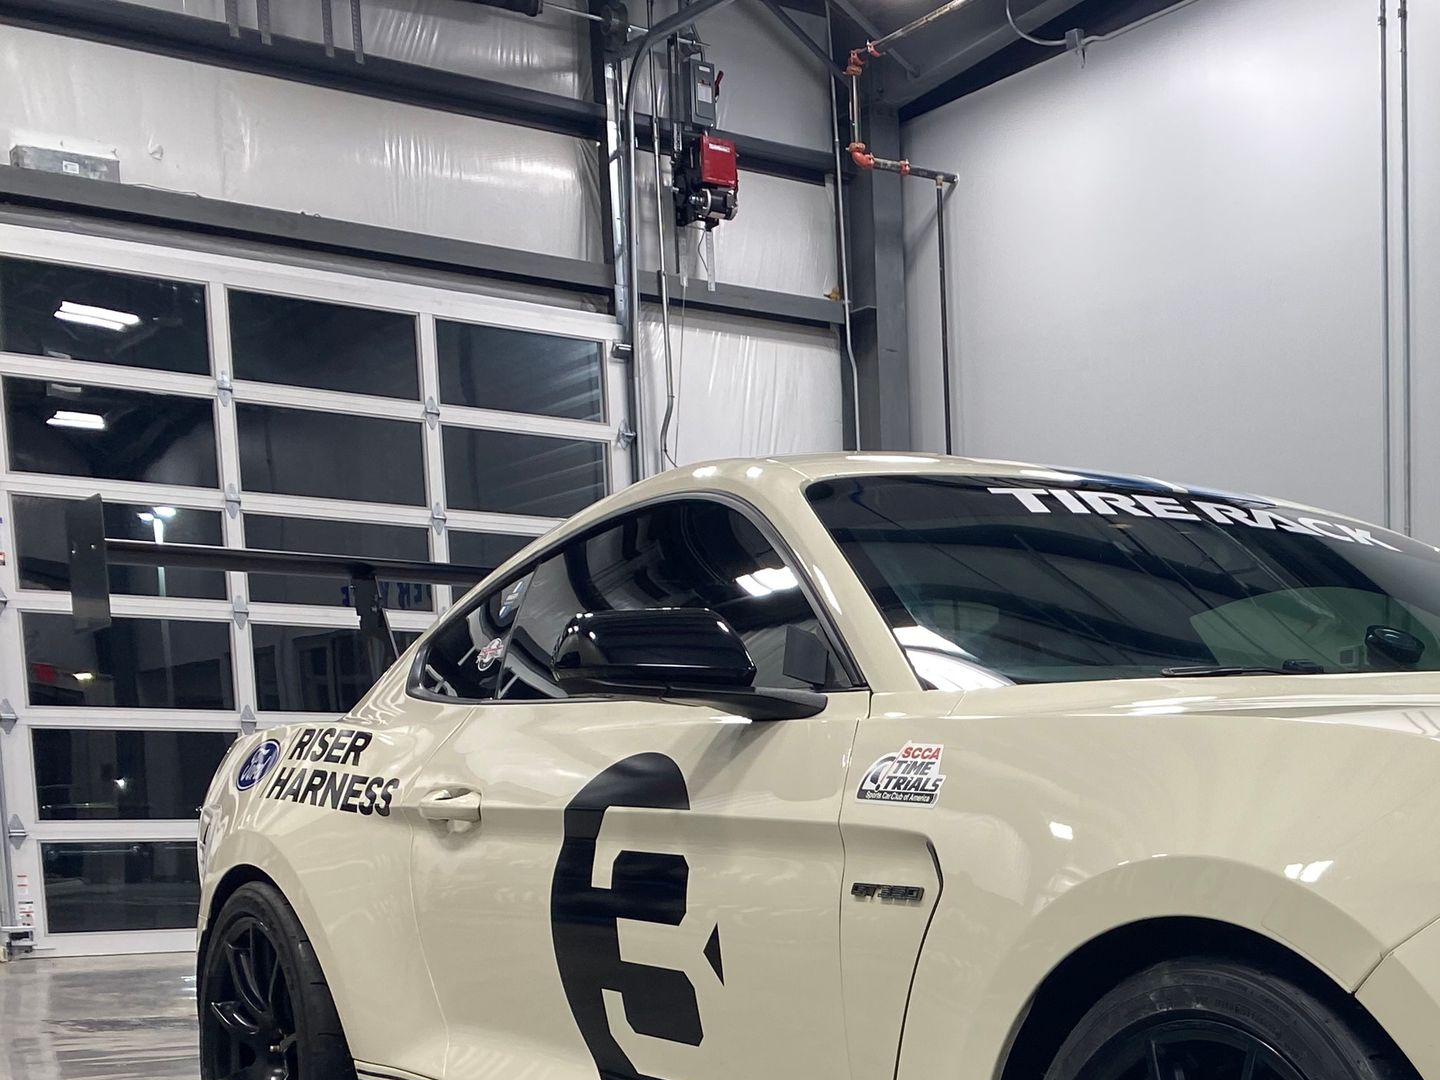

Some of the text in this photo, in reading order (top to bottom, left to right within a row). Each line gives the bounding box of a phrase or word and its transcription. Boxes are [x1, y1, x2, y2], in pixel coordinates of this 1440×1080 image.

[987, 487, 1402, 552] TIRE RACK
[288, 727, 373, 767] RISER
[901, 746, 941, 761] SCCA
[266, 767, 400, 817] HARNESS
[891, 792, 903, 801] Club
[909, 794, 931, 803] America
